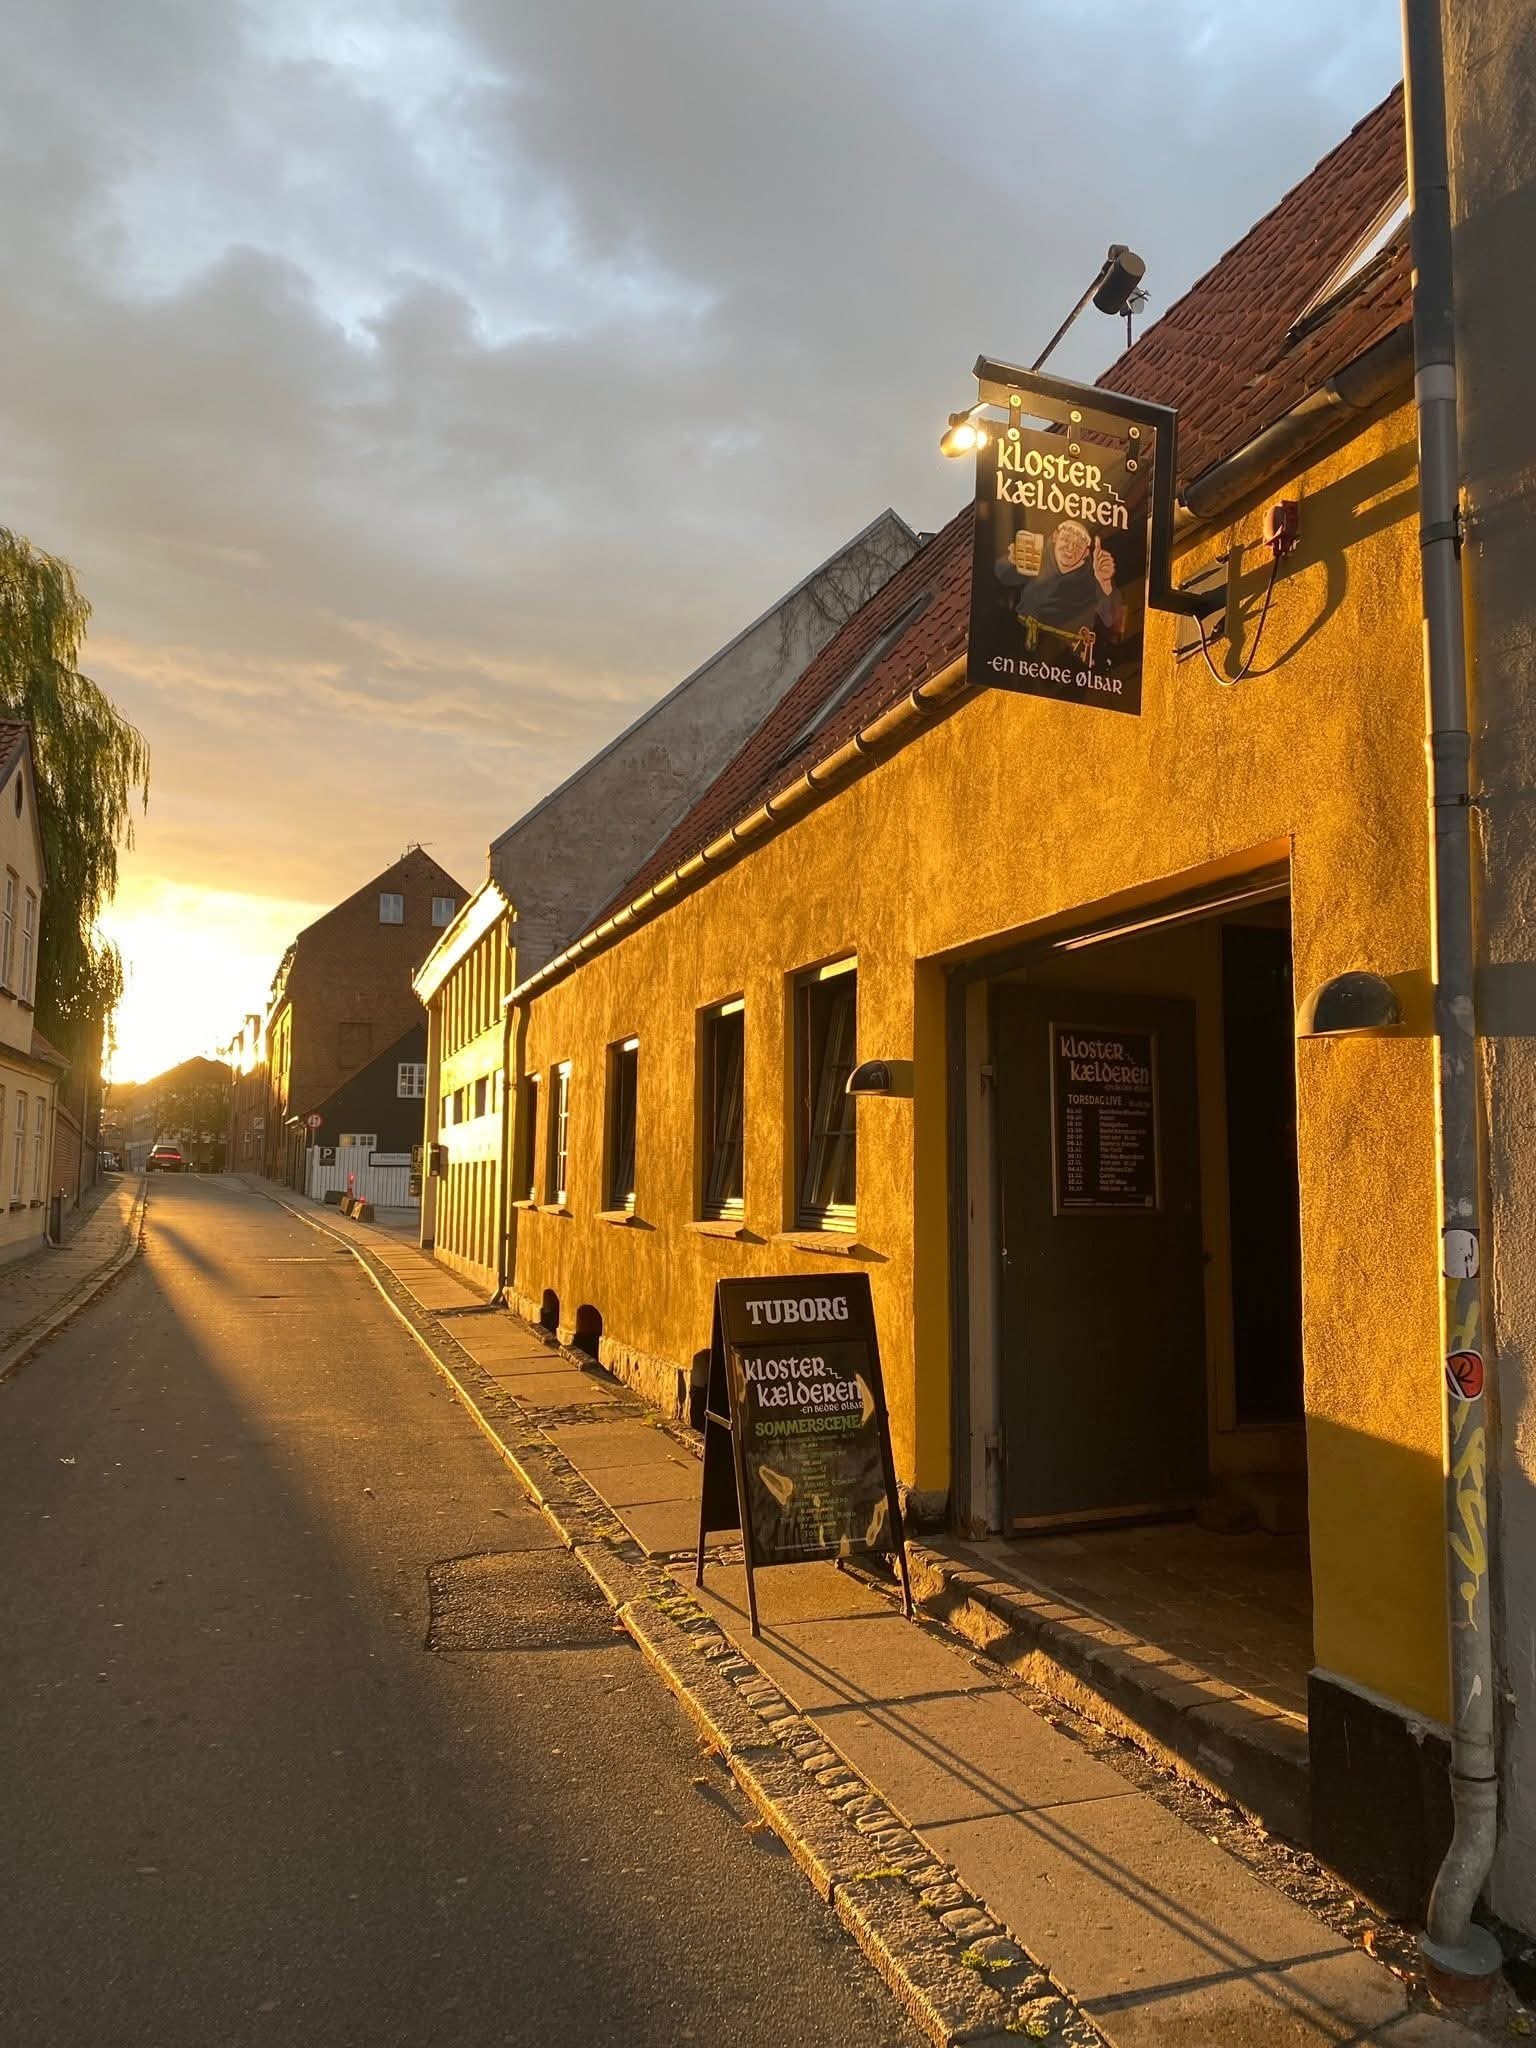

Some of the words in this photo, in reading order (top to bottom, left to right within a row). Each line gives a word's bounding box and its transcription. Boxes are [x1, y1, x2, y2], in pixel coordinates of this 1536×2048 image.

[1019, 660, 1071, 684] BEDRE
[1075, 670, 1122, 695] ØLBAR
[1067, 1093, 1104, 1105] TORSDAG
[1105, 1095, 1122, 1106] LIVE
[746, 1296, 849, 1325] TUBORG
[815, 1403, 839, 1413] BEDRE
